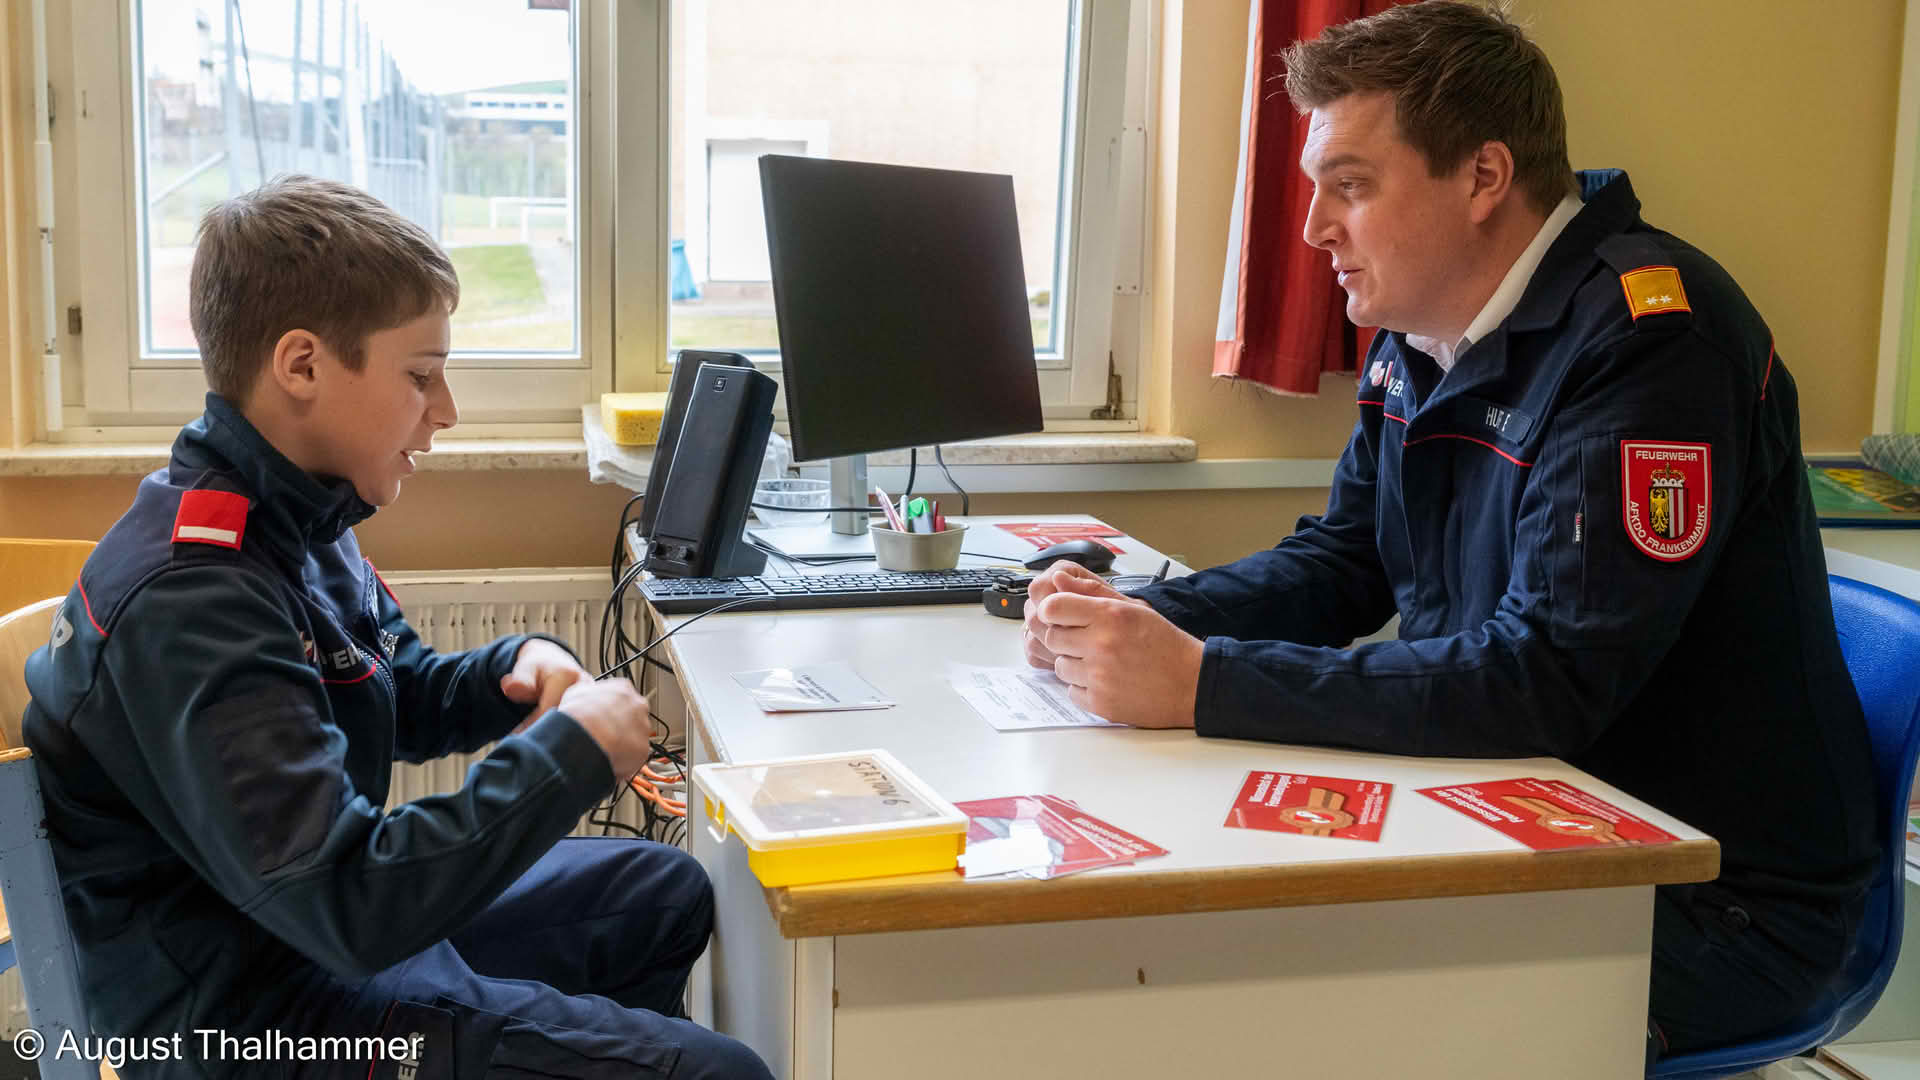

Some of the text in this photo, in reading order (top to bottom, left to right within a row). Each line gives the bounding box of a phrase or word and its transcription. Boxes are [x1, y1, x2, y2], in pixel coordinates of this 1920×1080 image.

[1635, 450, 1698, 461] FEUERWEHR
[1630, 500, 1647, 539] AFKDO
[1645, 503, 1706, 553] FRANKENMARKT
